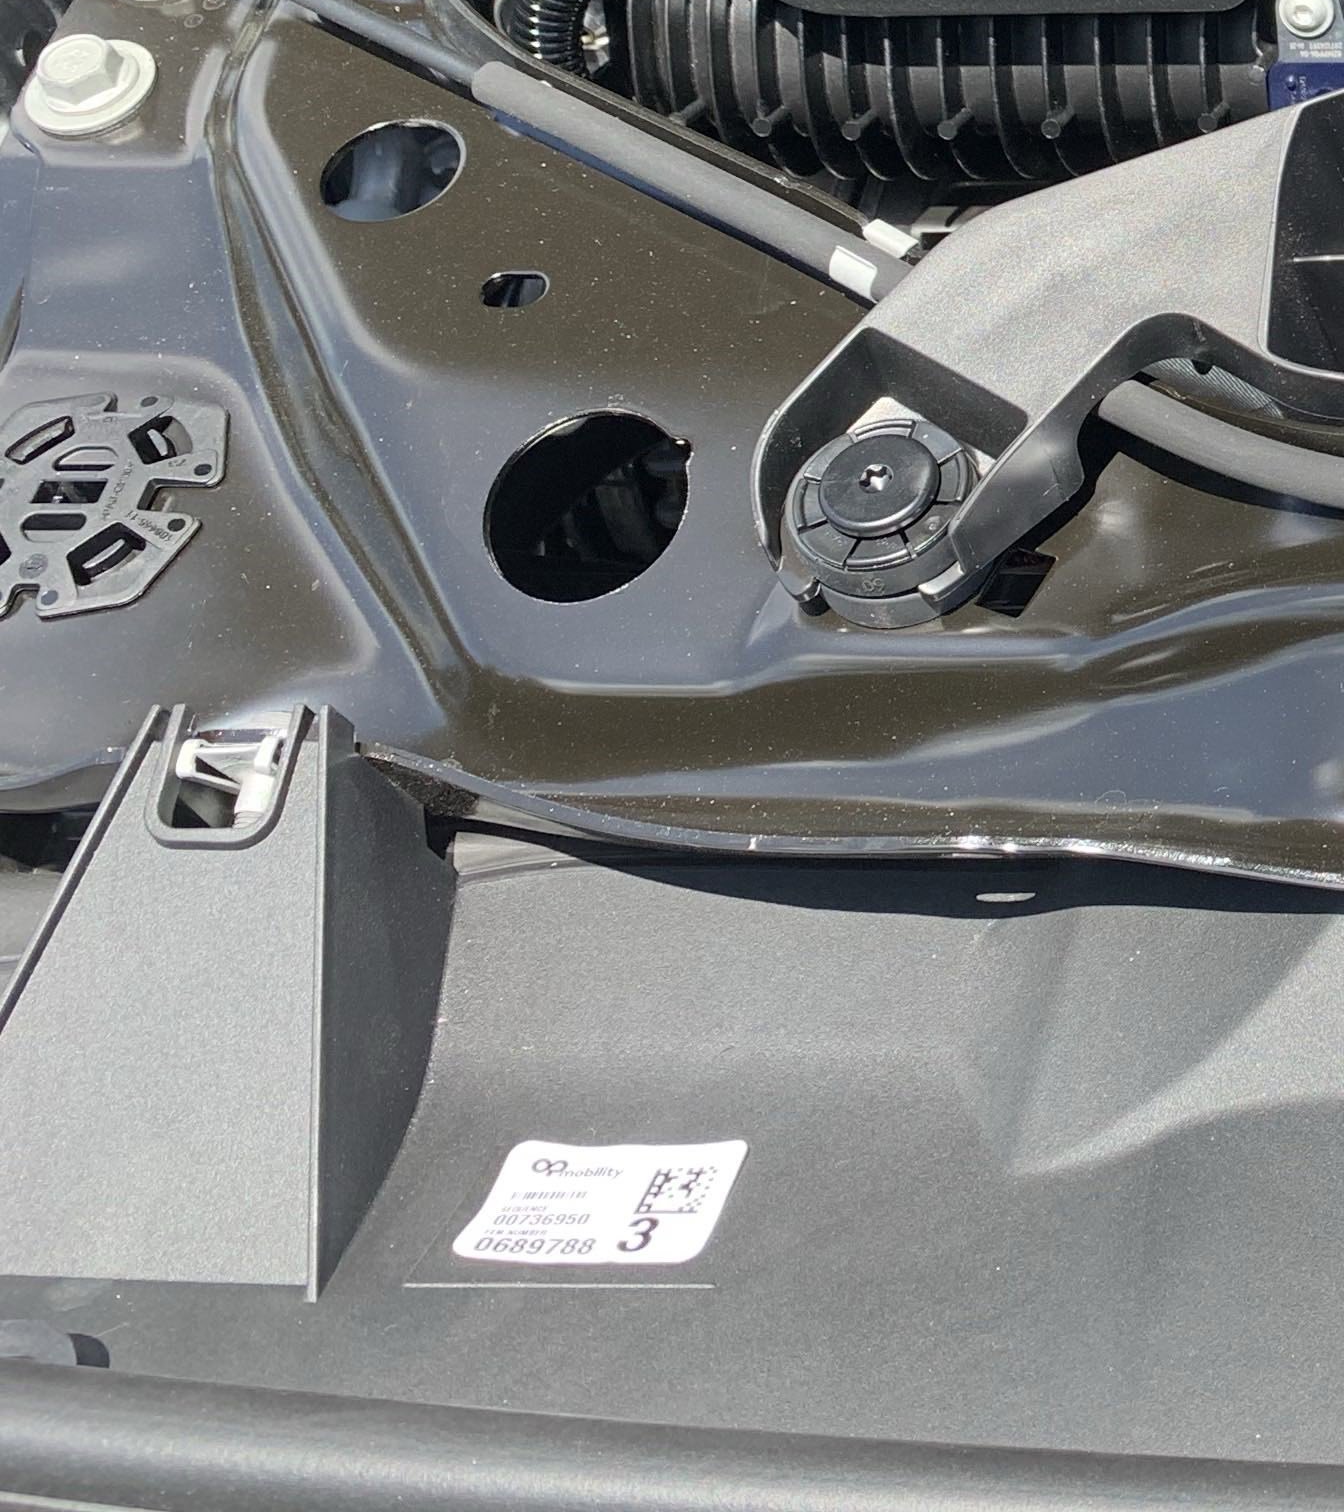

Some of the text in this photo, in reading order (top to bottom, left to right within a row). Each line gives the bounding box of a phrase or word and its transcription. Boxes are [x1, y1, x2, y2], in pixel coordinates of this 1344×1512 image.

[493, 1213, 591, 1226] 00736950
[617, 1217, 660, 1252] 3
[473, 1237, 597, 1255] 0689788
